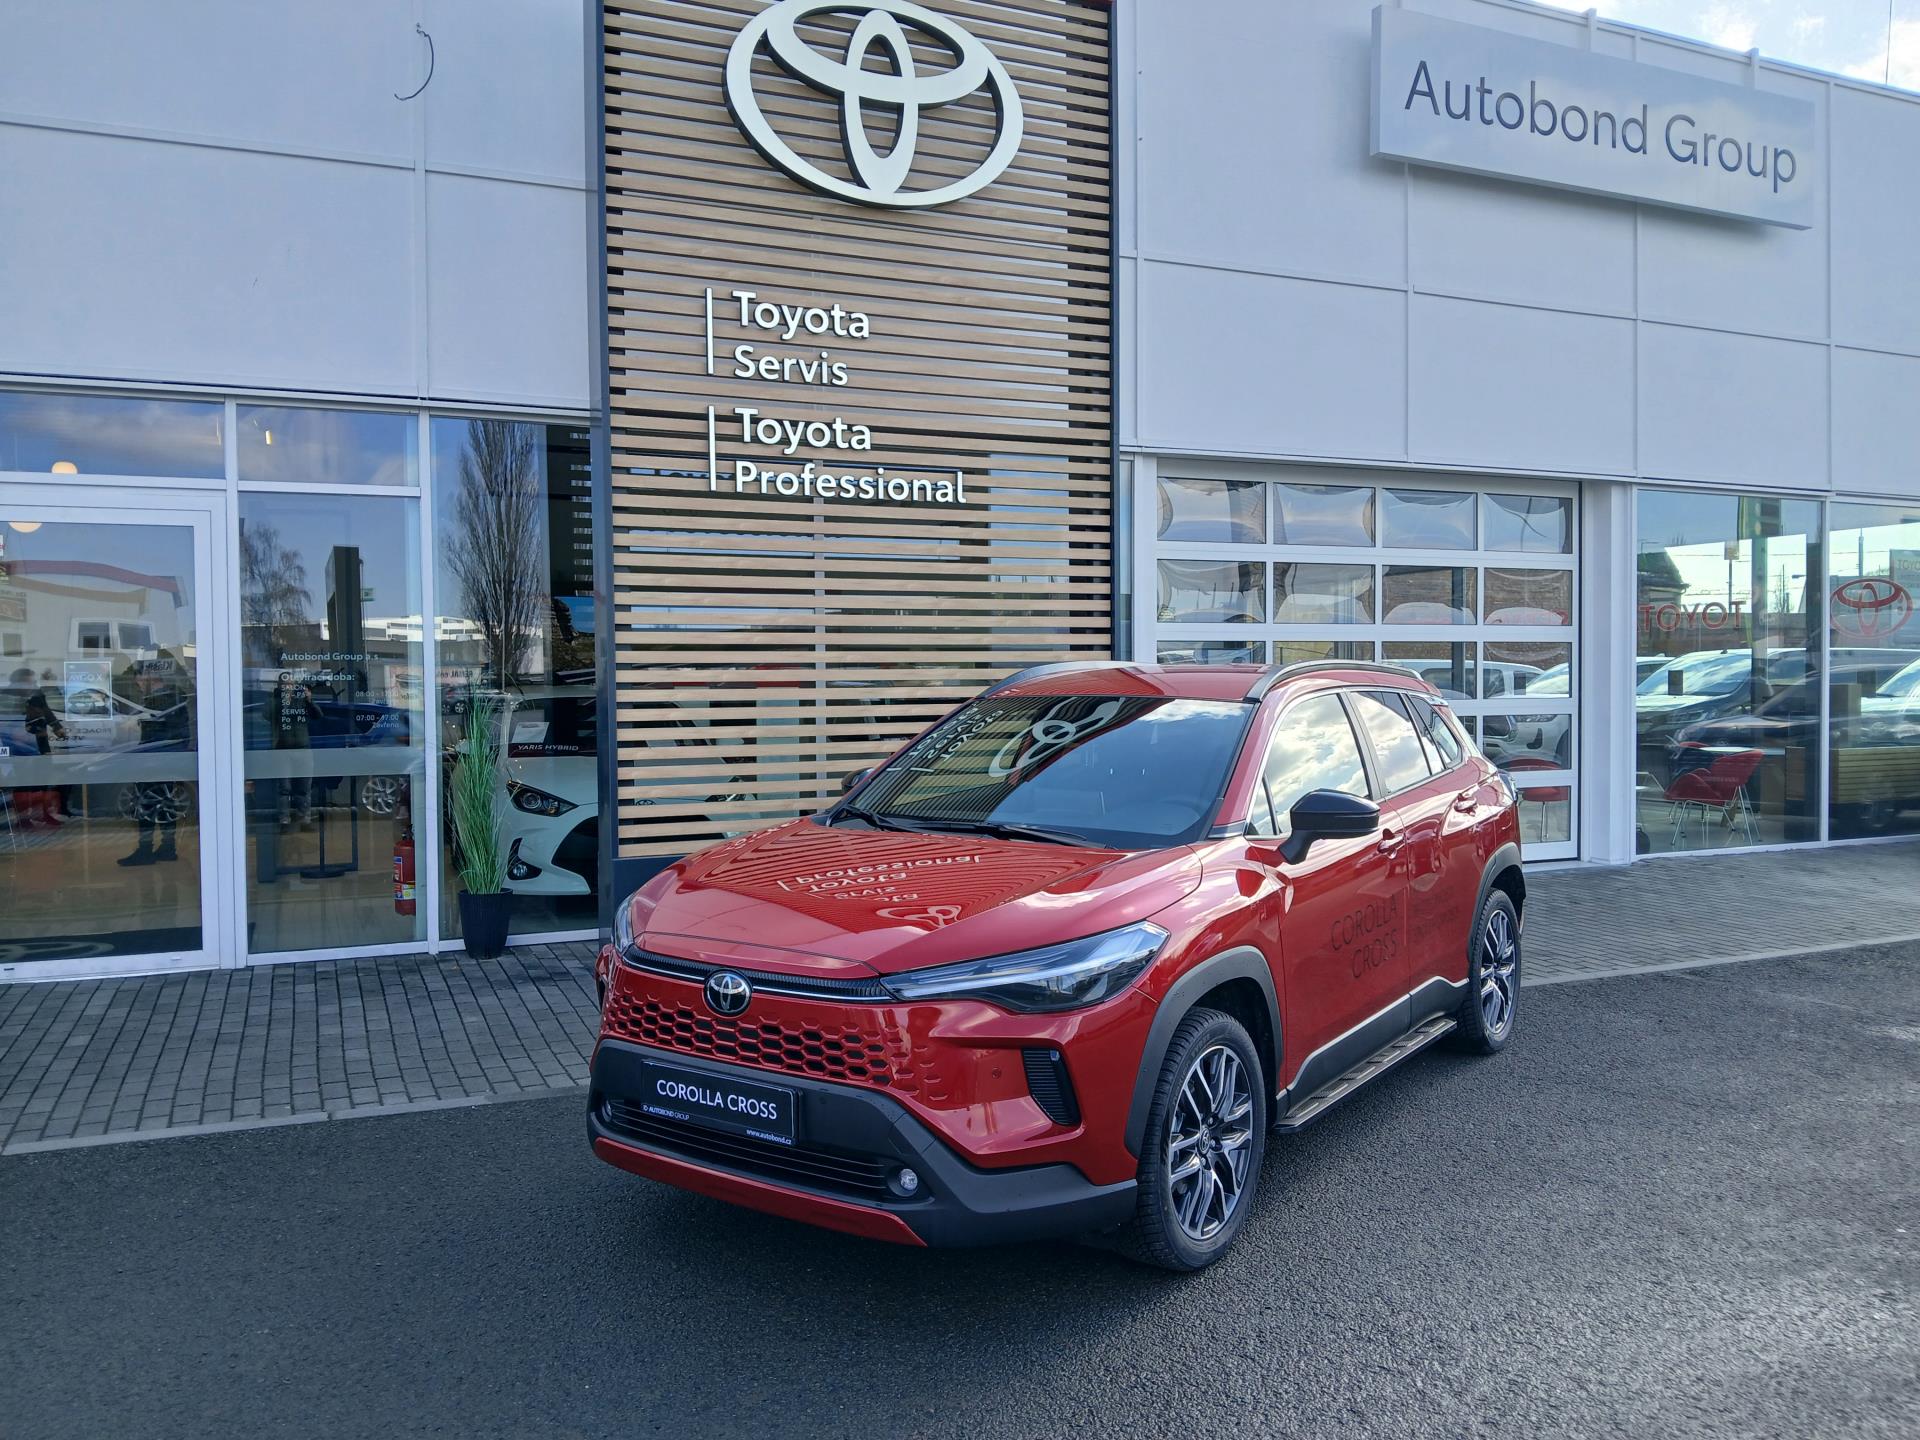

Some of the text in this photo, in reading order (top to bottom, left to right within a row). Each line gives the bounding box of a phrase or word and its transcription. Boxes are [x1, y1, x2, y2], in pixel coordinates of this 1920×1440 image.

[1404, 59, 1798, 193] Autobond Group
[732, 289, 871, 341] Toyota
[733, 344, 849, 387] Servis
[733, 407, 872, 456] Toyota
[734, 460, 967, 504] Professional
[281, 652, 331, 661] Autobond
[332, 652, 363, 662] Group
[329, 673, 355, 681] doba:
[545, 744, 579, 752] HYBRID
[1331, 894, 1397, 950] COROLLA
[1352, 928, 1397, 978] CROSS
[656, 1079, 777, 1120] COROLLA CROSS
[746, 1128, 792, 1145] www.autobond.cz
